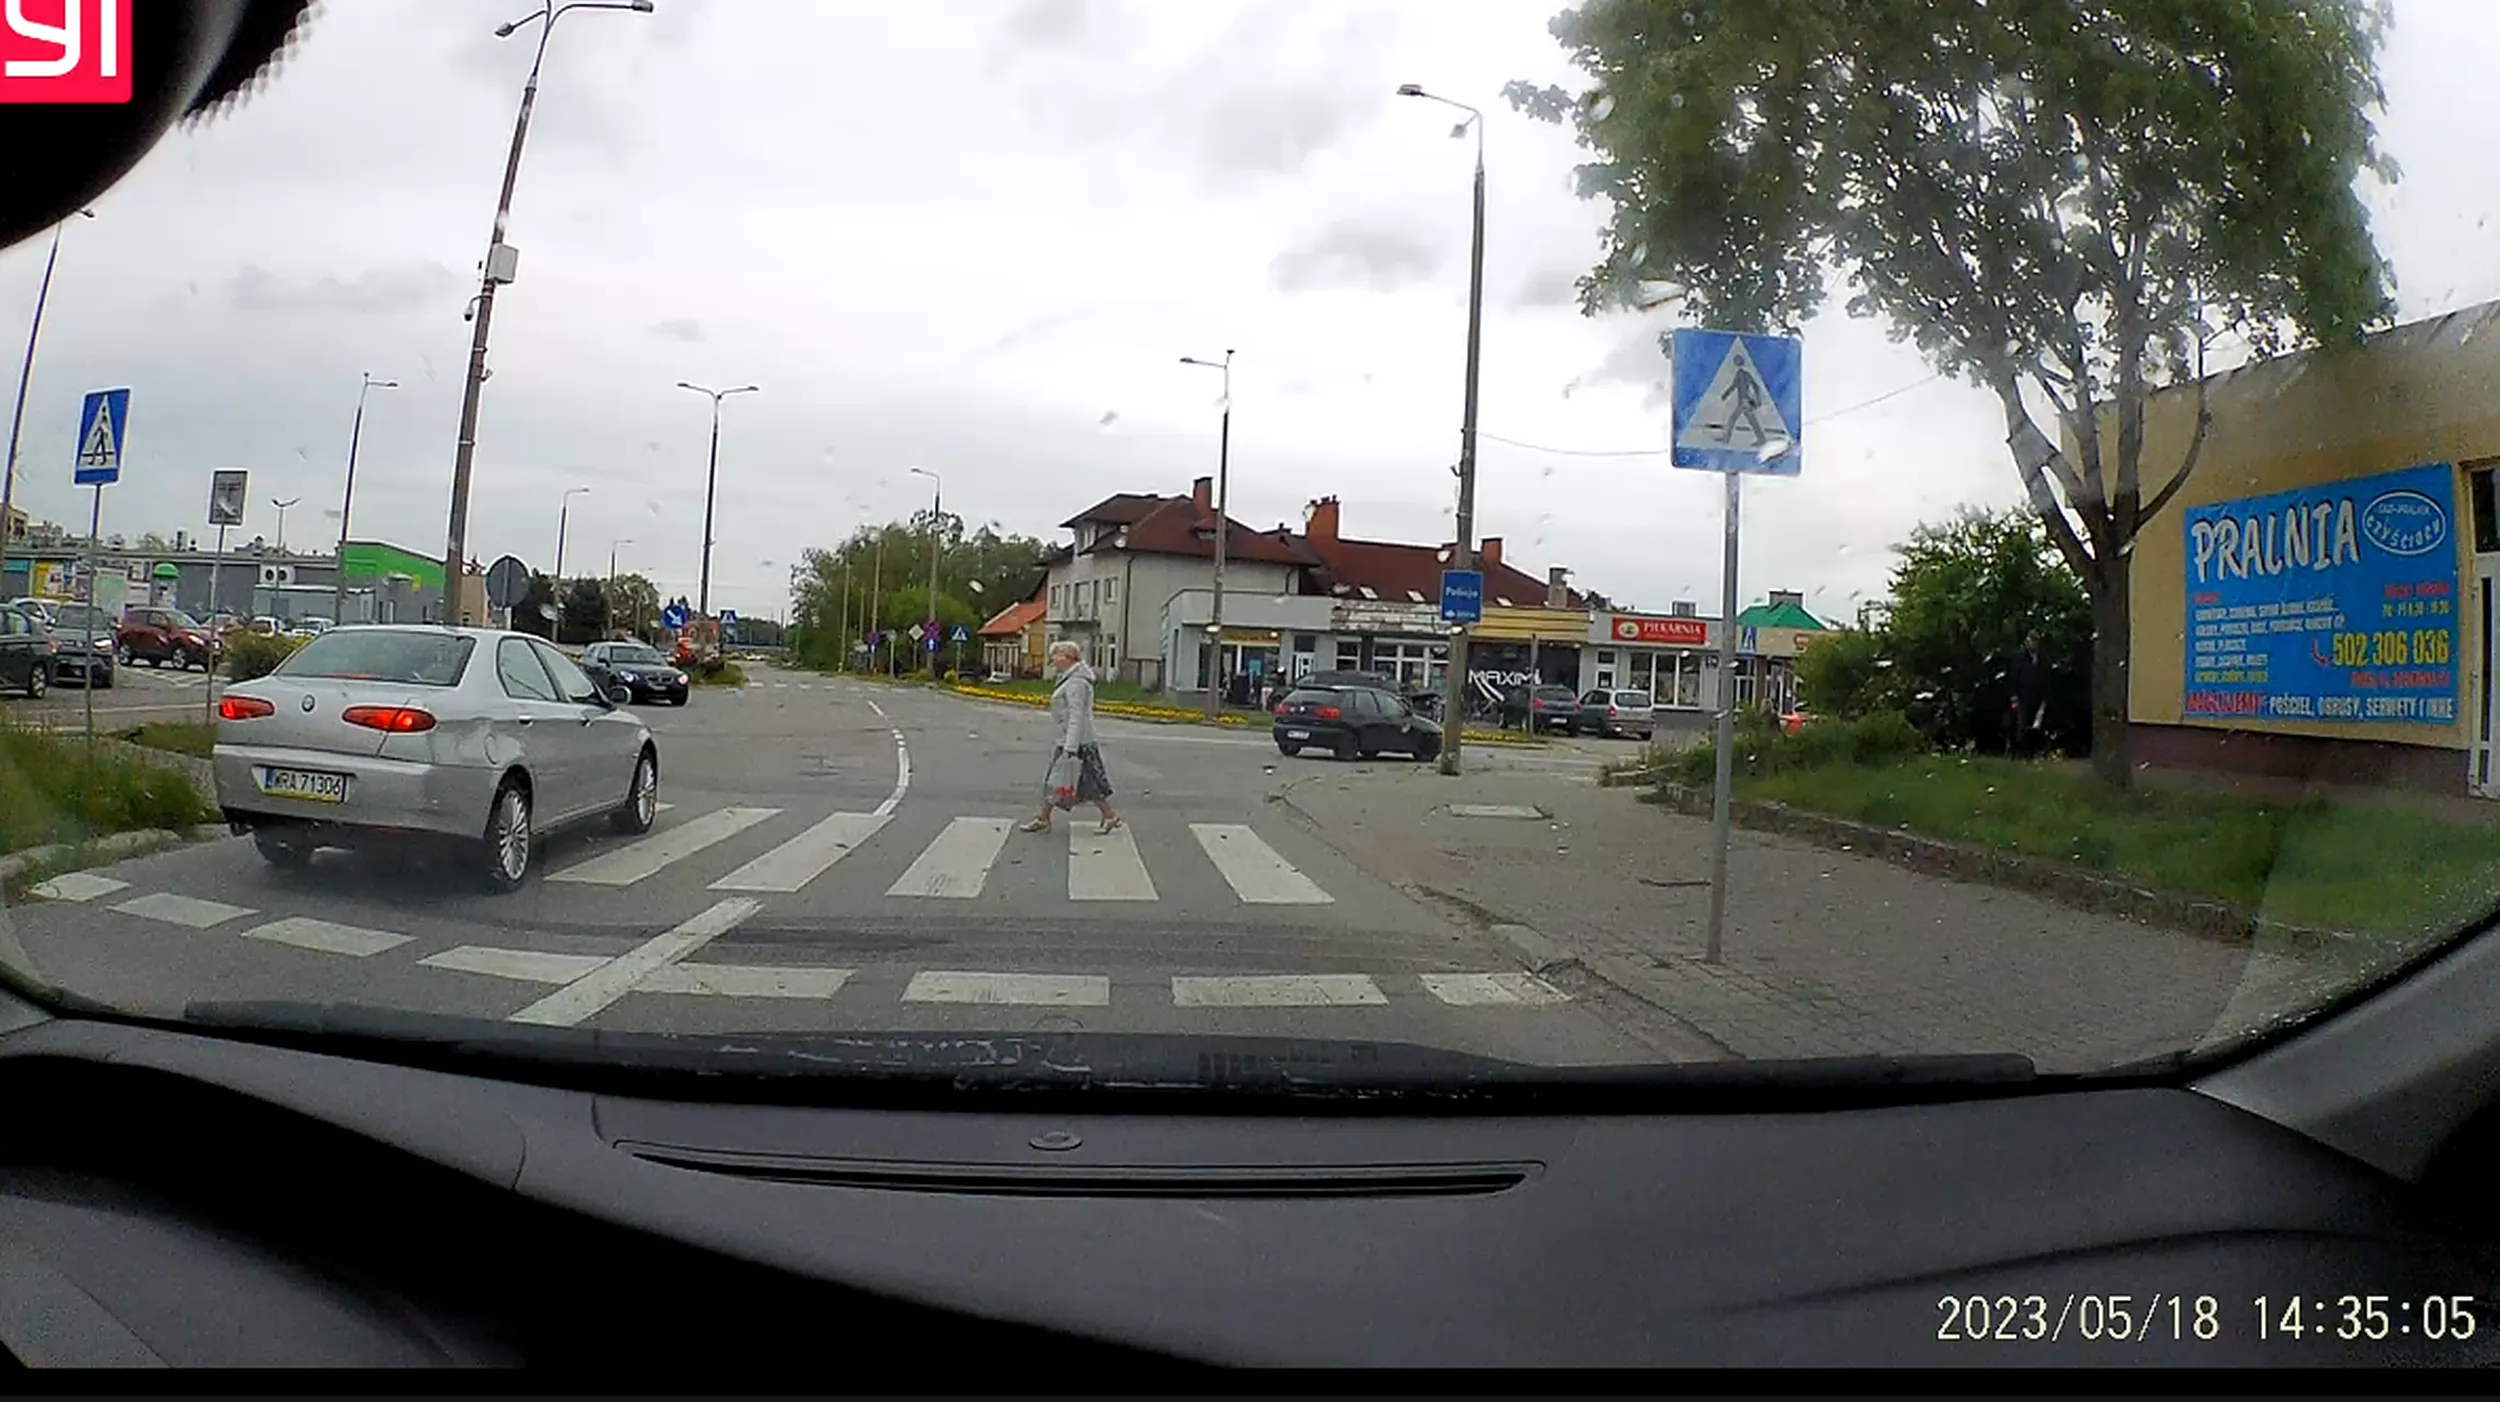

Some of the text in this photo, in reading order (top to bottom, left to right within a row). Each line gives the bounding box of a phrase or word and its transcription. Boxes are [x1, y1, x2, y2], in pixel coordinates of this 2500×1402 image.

[2192, 497, 2360, 582] PRALNIA
[1643, 622, 1702, 635] PIEKARNIA
[2333, 629, 2450, 667] 502 306 036
[275, 770, 342, 795] WRA 71306
